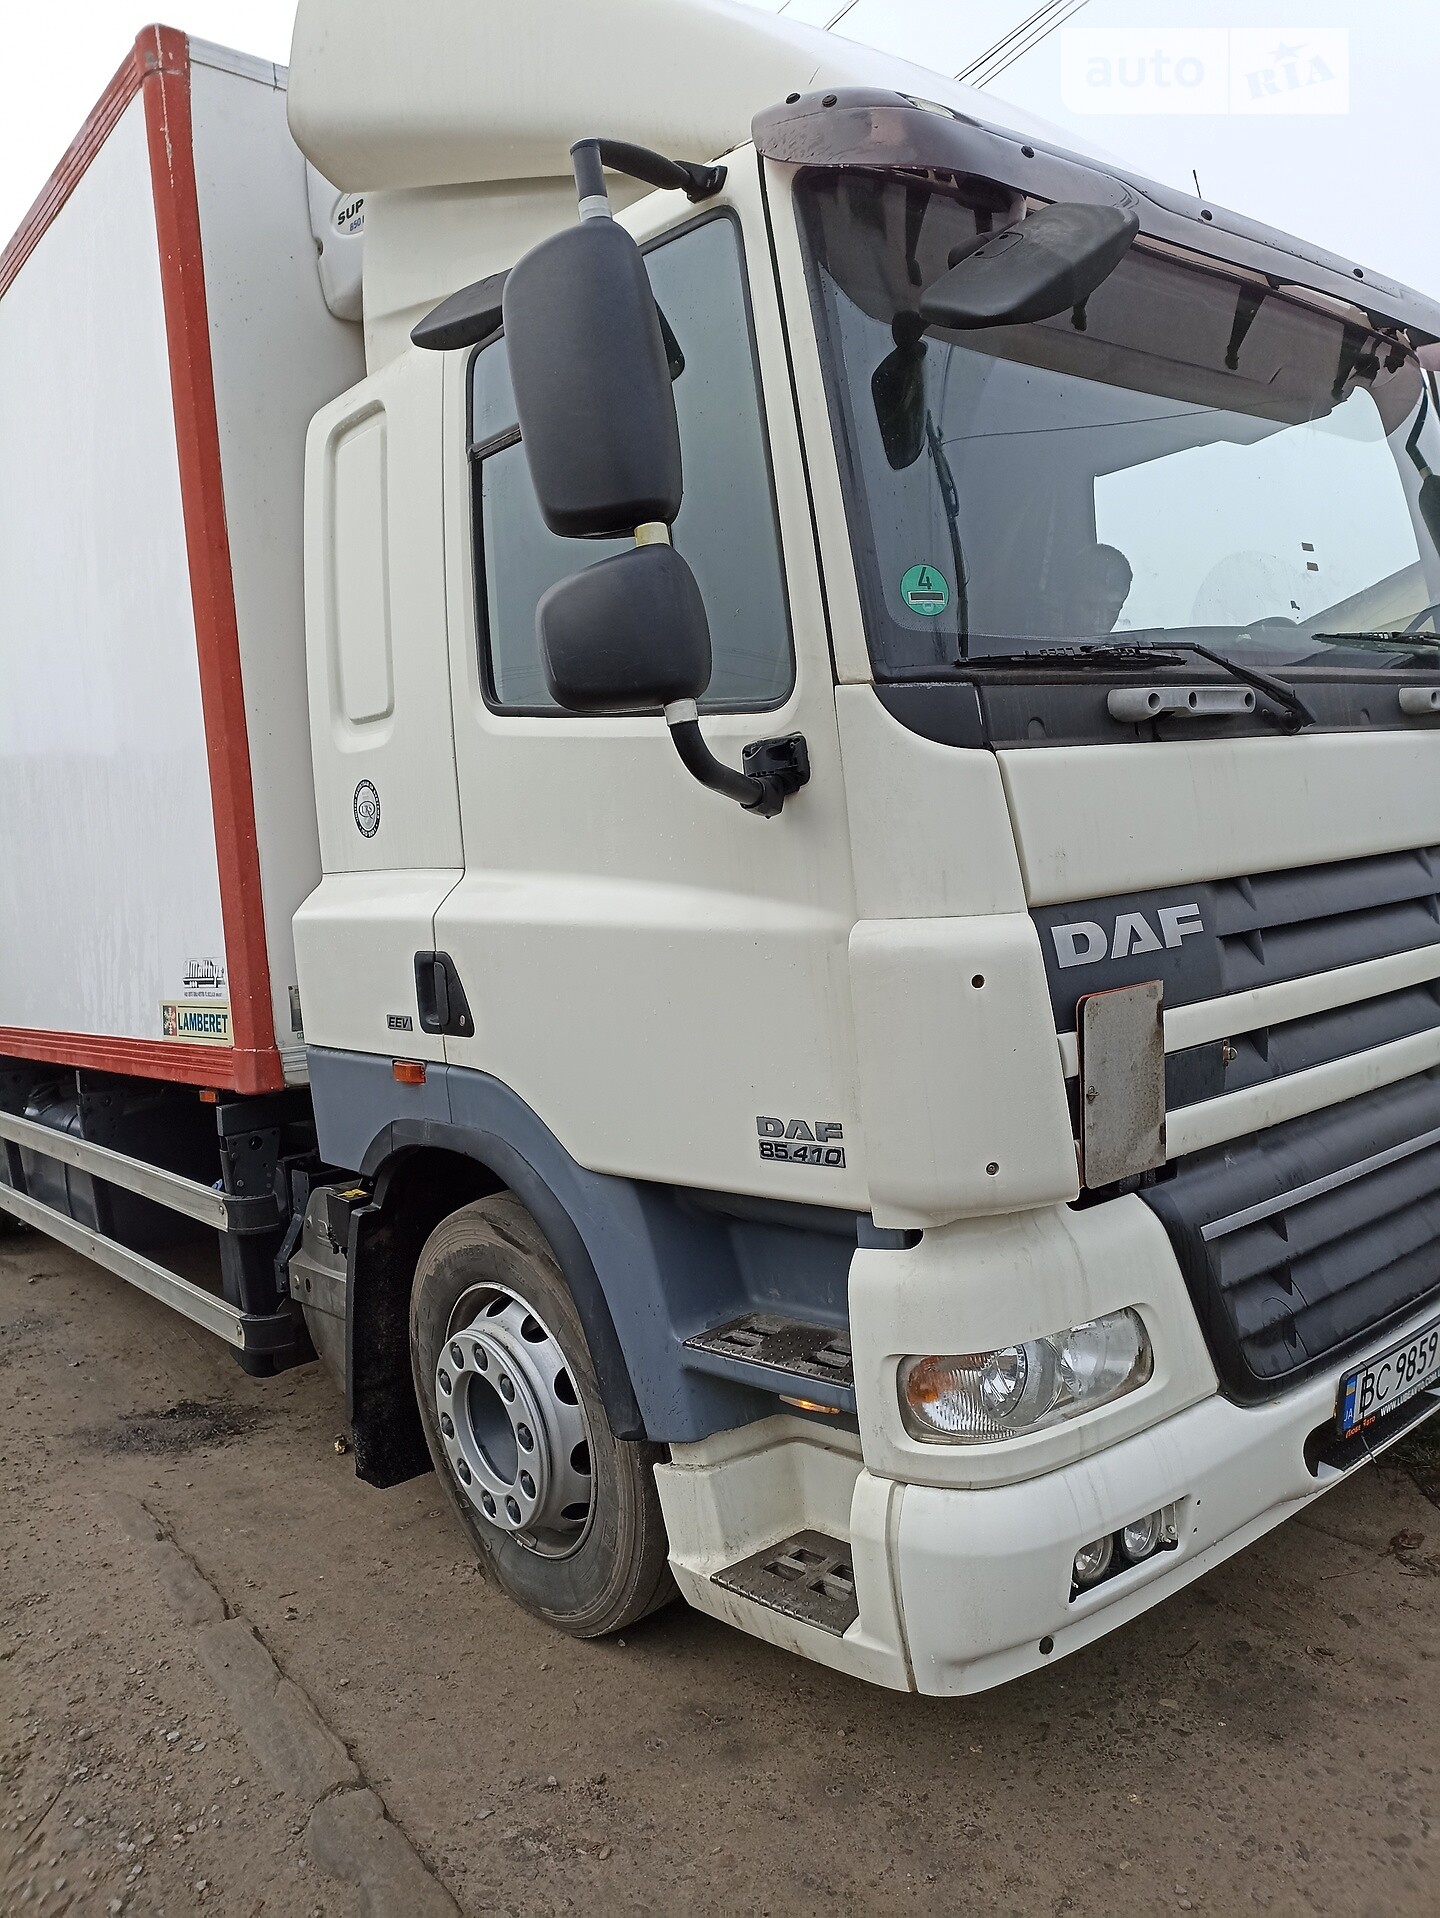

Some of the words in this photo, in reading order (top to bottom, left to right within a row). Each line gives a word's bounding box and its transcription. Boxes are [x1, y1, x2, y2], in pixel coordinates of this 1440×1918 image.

[337, 198, 364, 226] SUP
[918, 566, 933, 590] 4
[1050, 903, 1204, 969] DAF
[178, 1012, 228, 1033] LAMBERET
[388, 1016, 409, 1028] EEV
[756, 1116, 843, 1142] DAF
[759, 1141, 843, 1165] 85.410
[1359, 1362, 1392, 1415] BC
[1395, 1331, 1439, 1391] 9859
